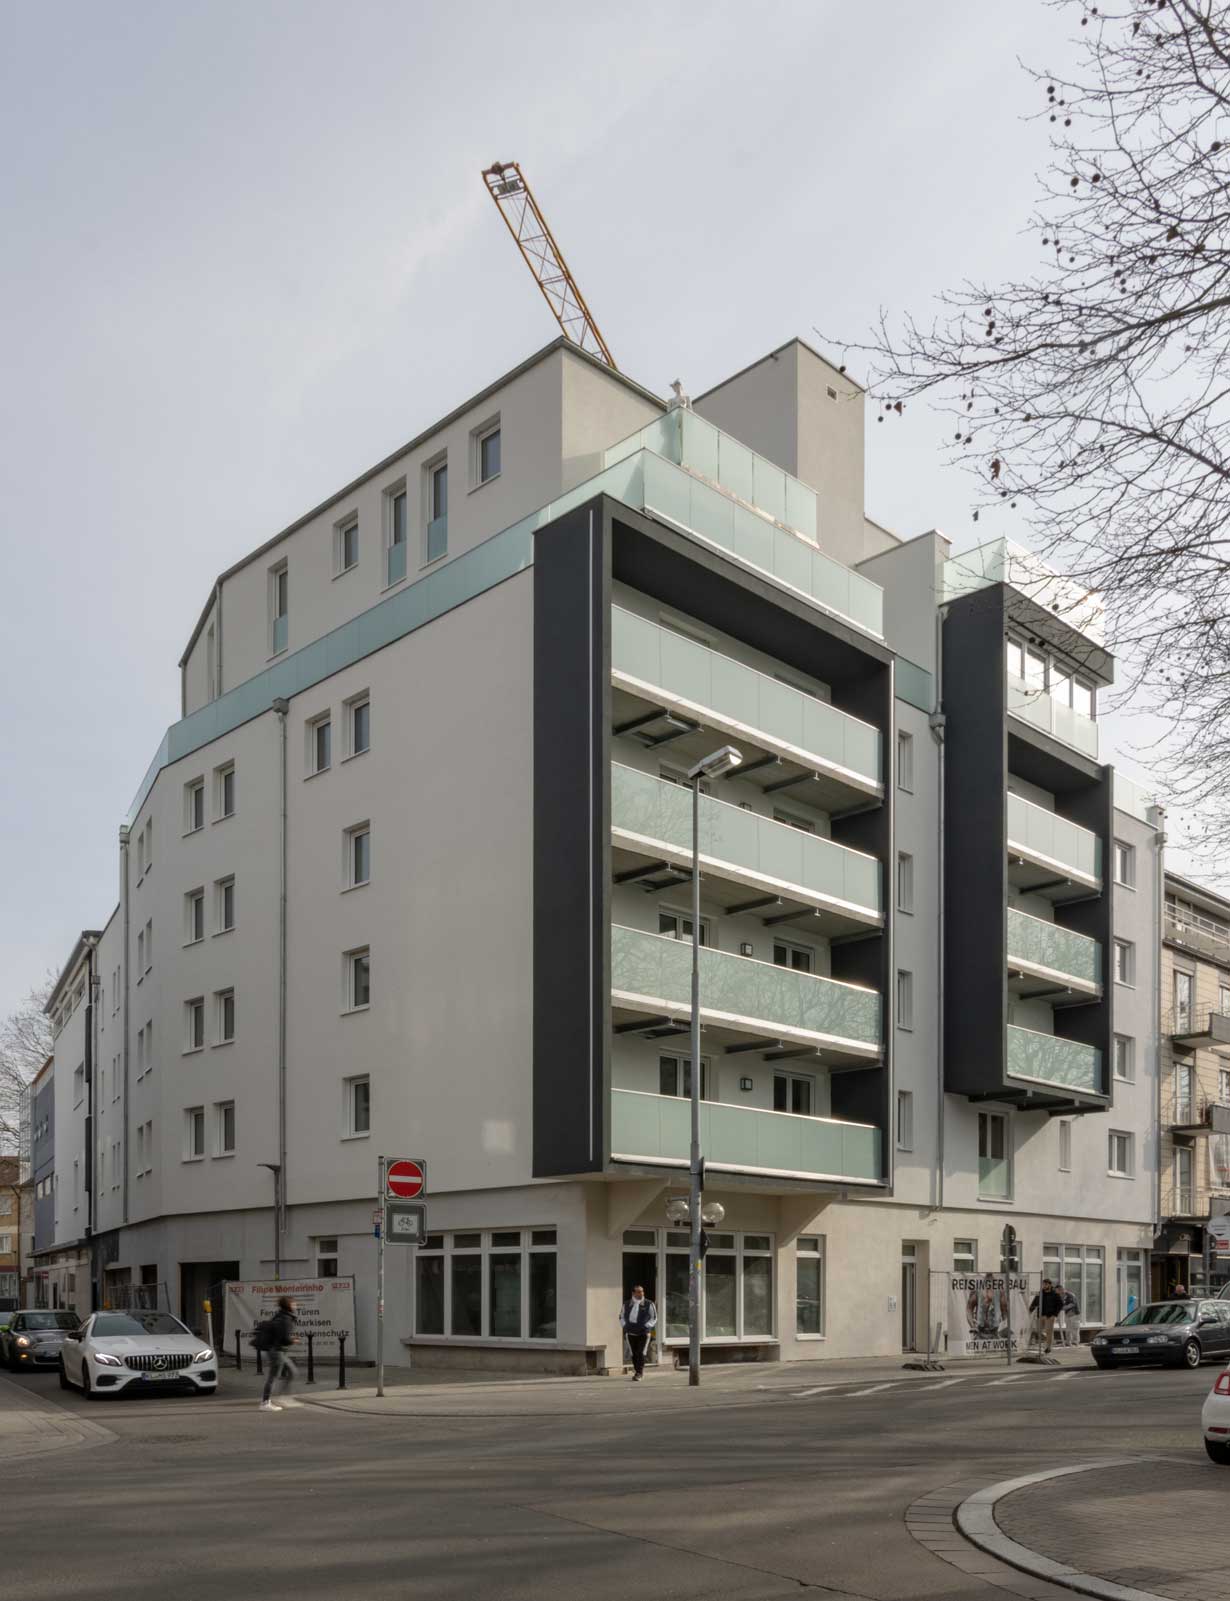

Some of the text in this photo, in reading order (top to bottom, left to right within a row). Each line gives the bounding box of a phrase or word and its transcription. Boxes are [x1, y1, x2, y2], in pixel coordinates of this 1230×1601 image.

[952, 1279, 1027, 1290] REISINGER BAU
[297, 1308, 320, 1316] Türen
[295, 1319, 332, 1327] Markisen
[288, 1330, 350, 1338] nsektenschutz
[966, 1341, 979, 1350] MEN
[982, 1341, 991, 1350] AT
